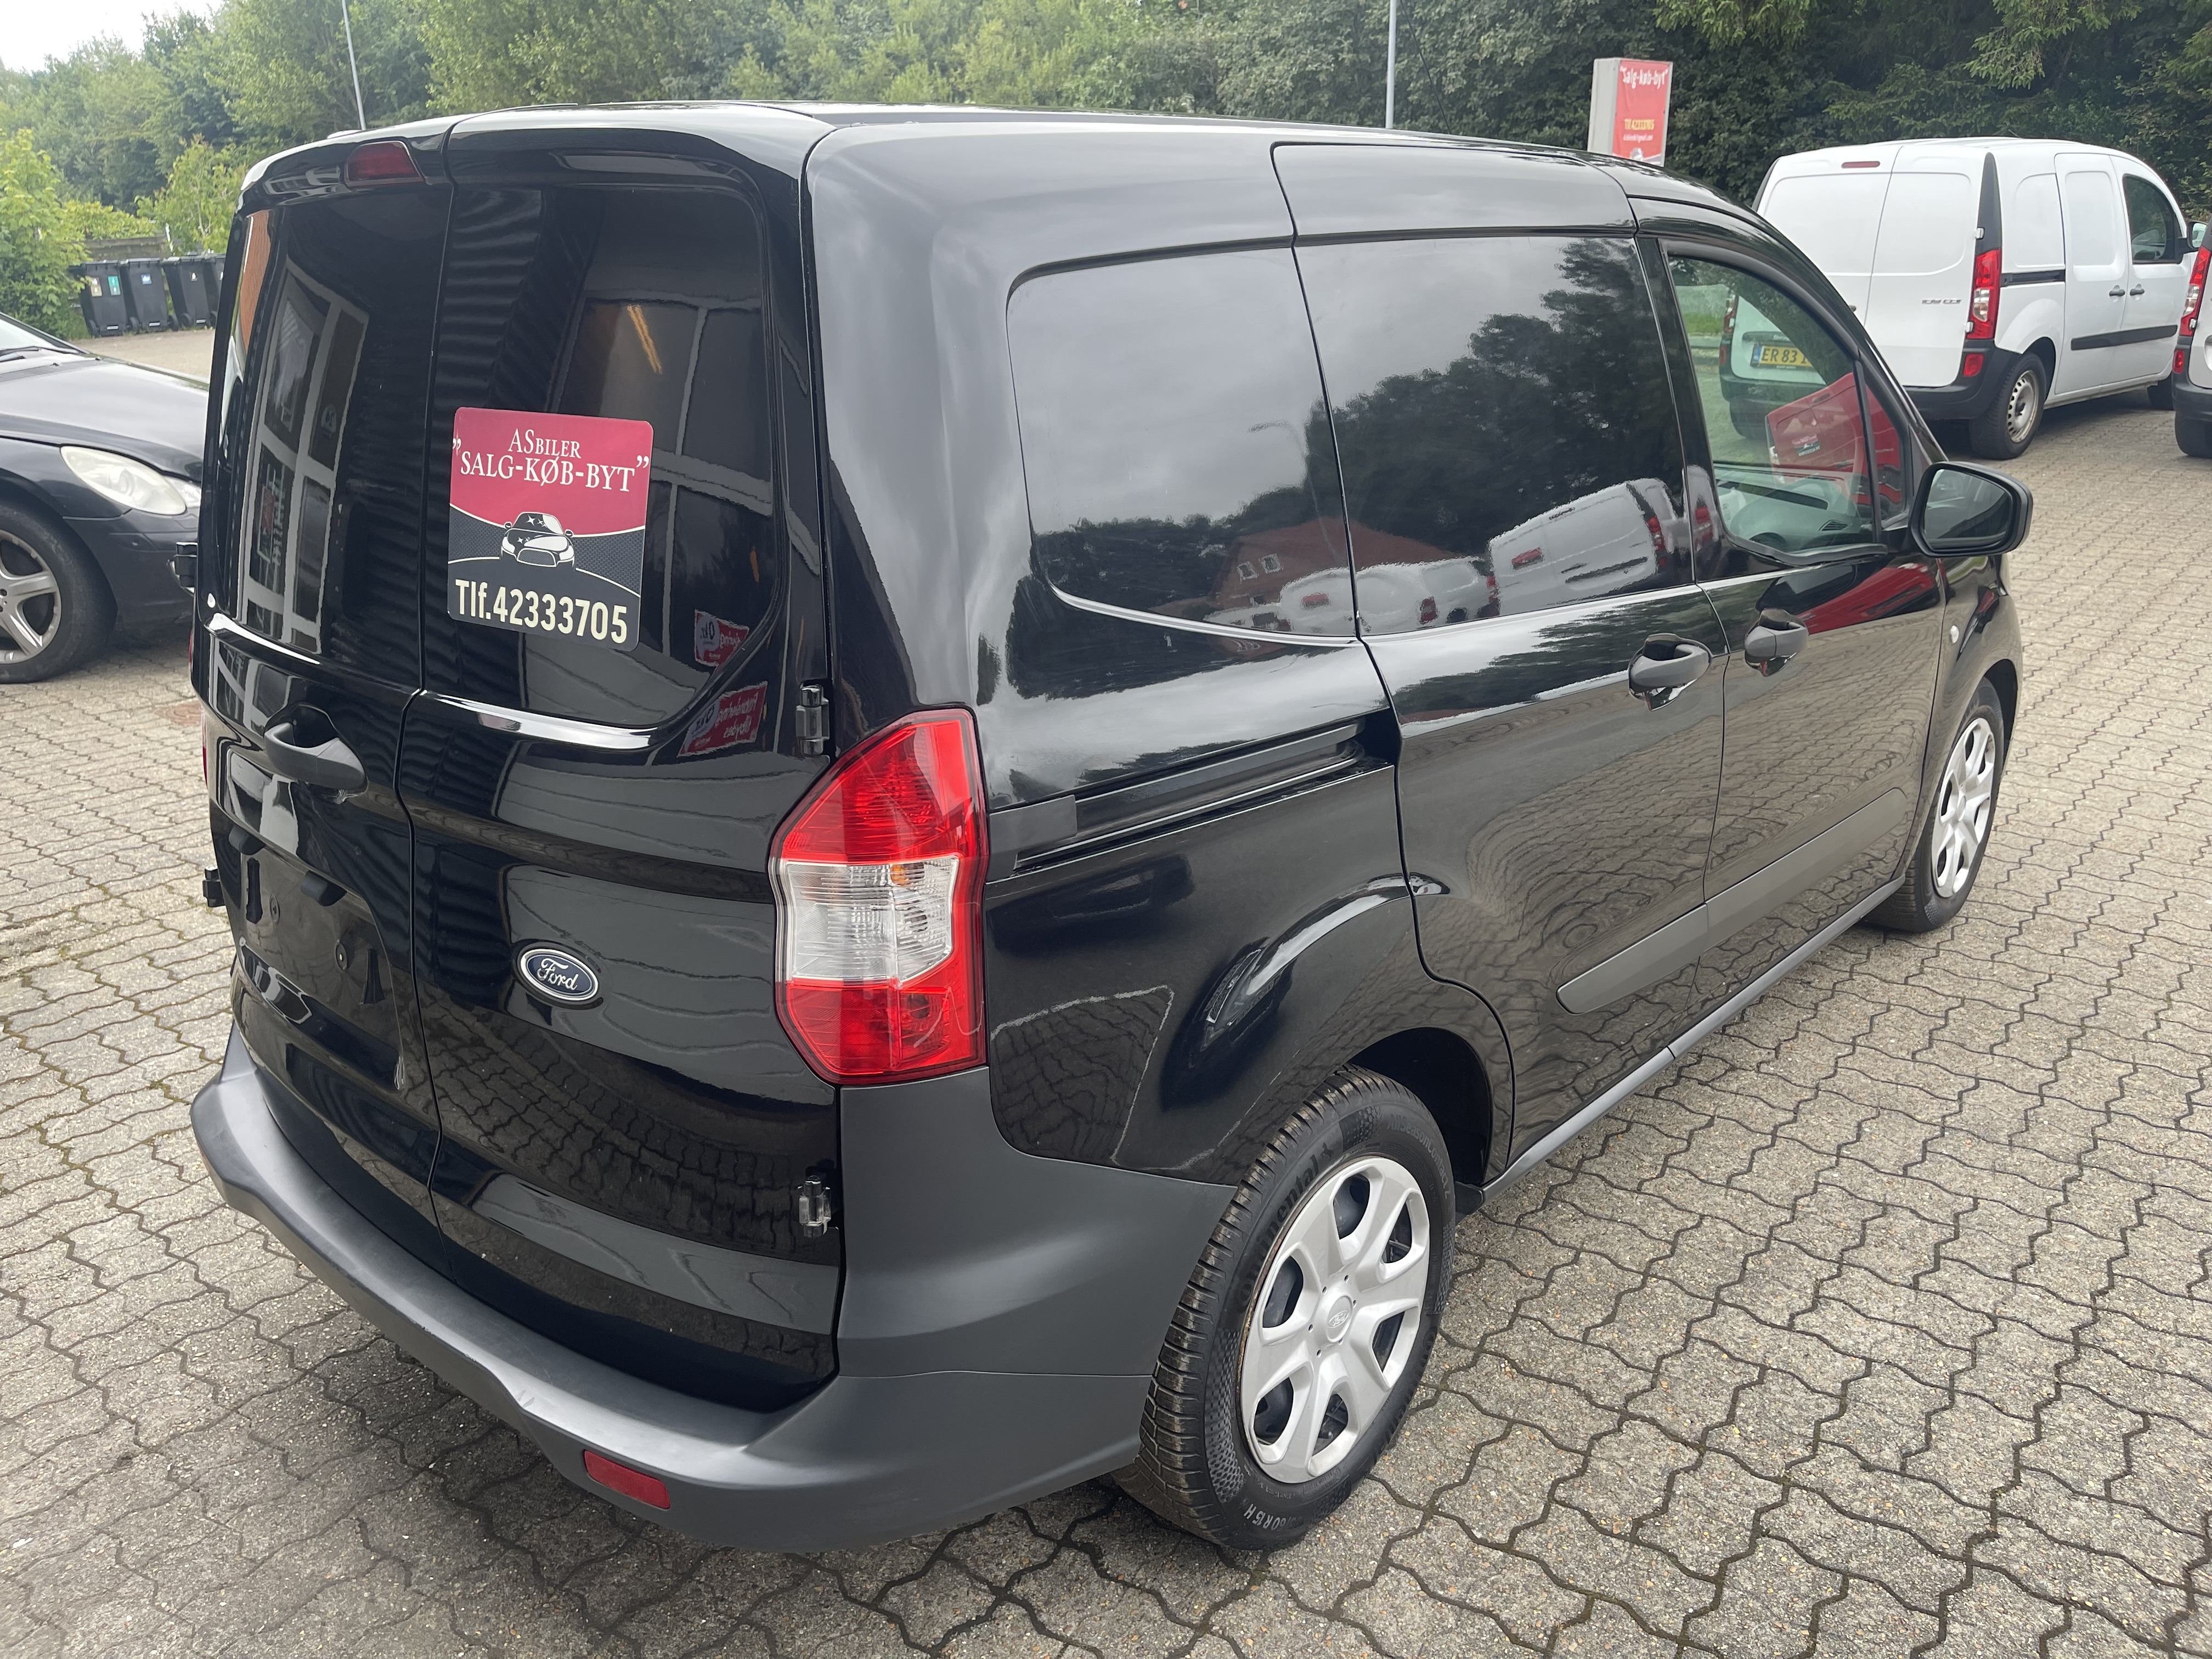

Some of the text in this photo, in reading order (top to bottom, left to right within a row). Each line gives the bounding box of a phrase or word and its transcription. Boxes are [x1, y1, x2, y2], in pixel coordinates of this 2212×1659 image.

[1761, 348, 1780, 362] ER
[1781, 349, 1798, 363] 83
[455, 579, 628, 644] Tlf.42333705
[537, 958, 579, 990] Ford
